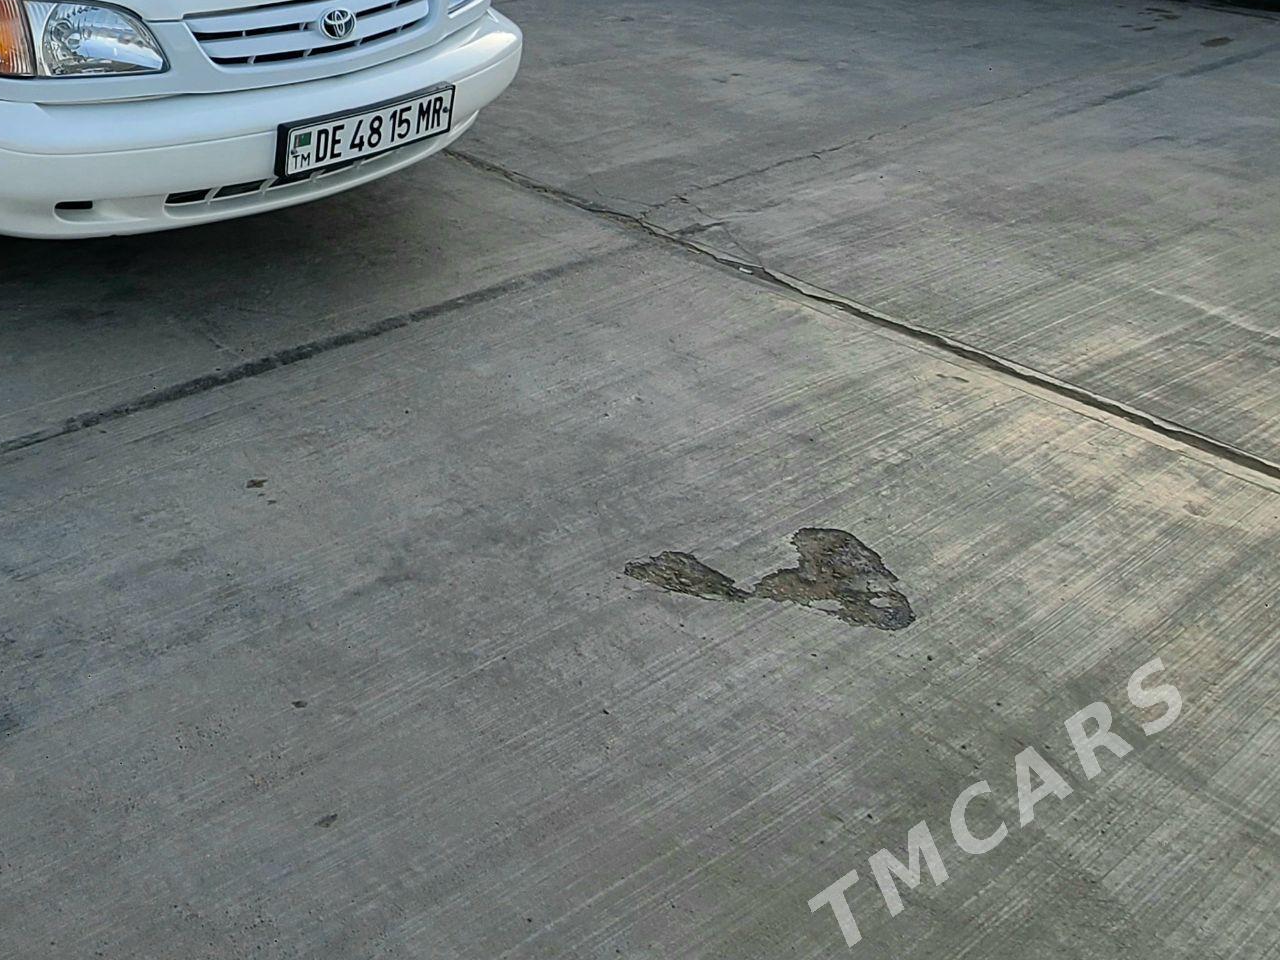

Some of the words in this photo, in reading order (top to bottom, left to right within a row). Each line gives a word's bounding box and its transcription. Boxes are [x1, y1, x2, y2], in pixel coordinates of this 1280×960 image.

[315, 124, 345, 163] DE
[349, 115, 383, 151] 48
[389, 106, 412, 142] 15
[416, 96, 444, 134] MR
[293, 152, 310, 169] TM
